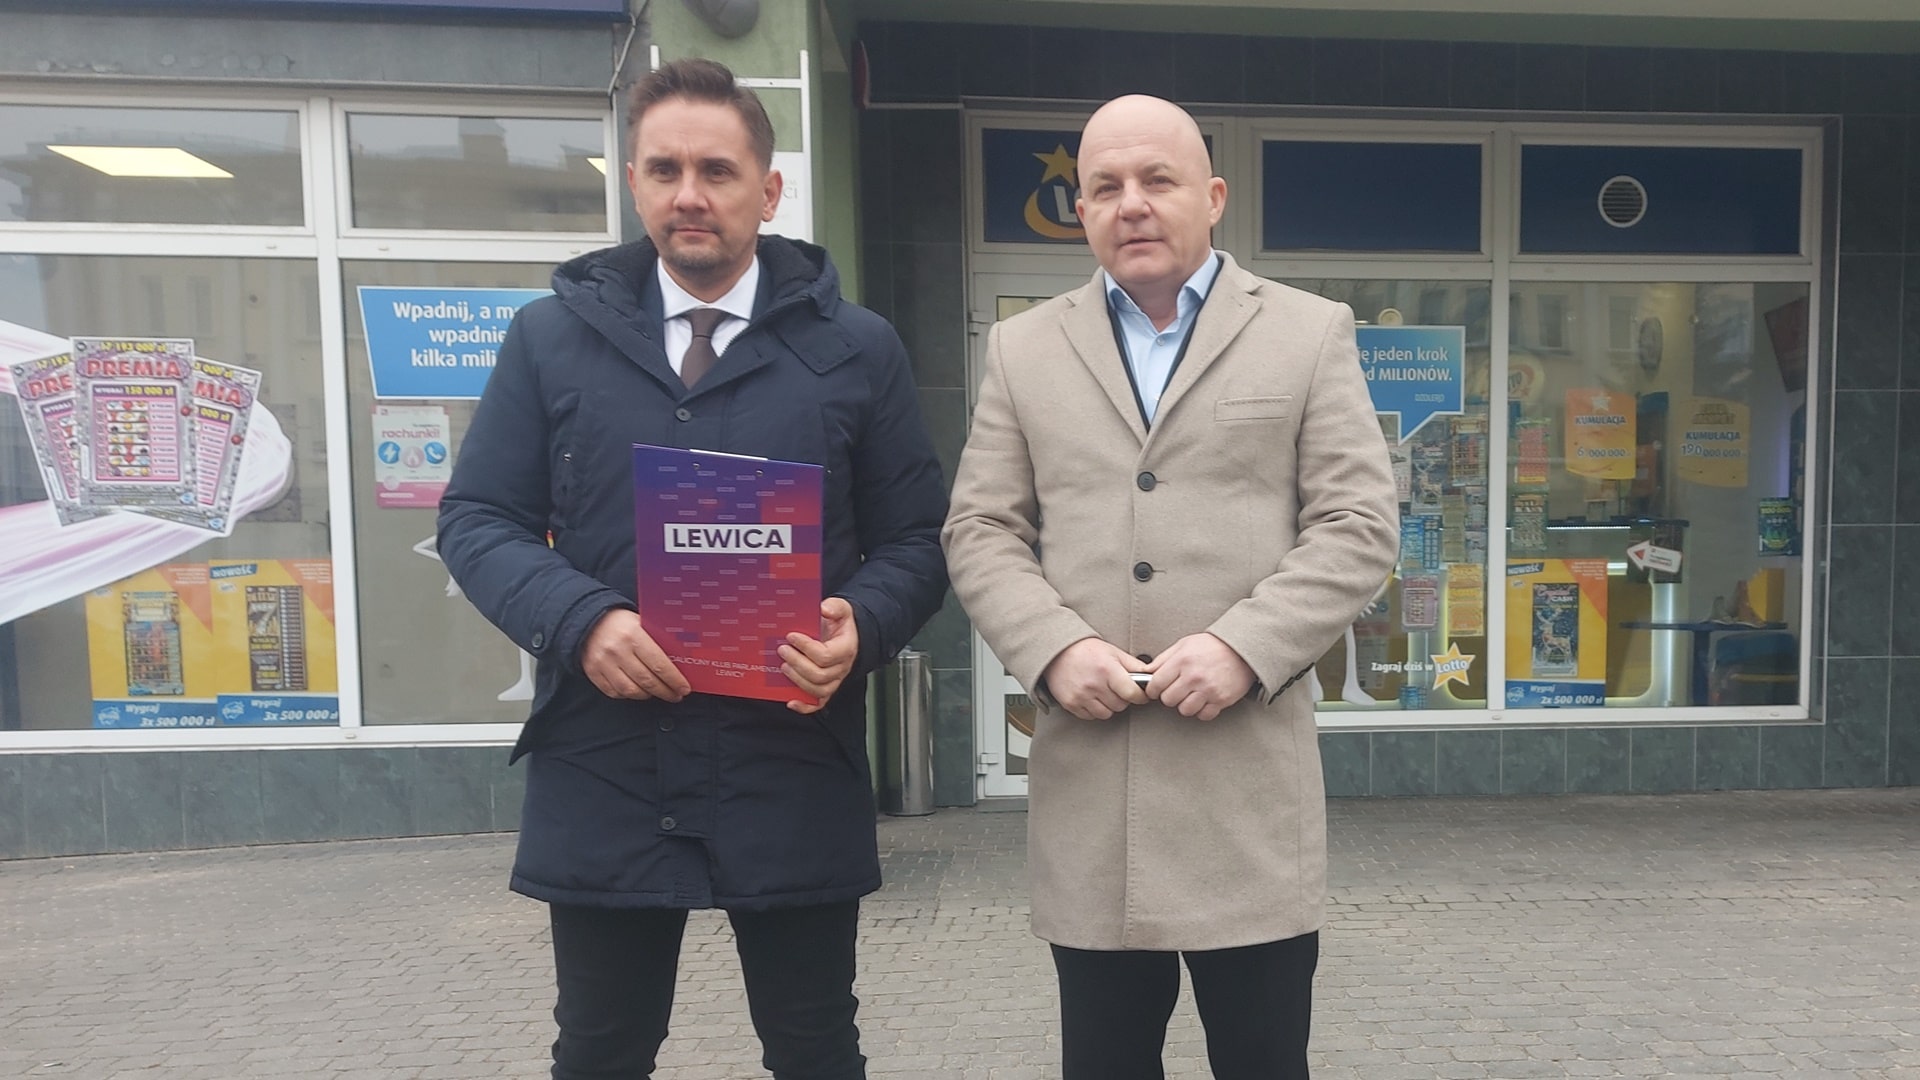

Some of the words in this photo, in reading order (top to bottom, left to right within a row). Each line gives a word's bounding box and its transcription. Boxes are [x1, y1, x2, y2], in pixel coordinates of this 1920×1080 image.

[393, 302, 474, 321] Wpadnij,
[480, 306, 491, 320] a
[496, 306, 520, 320] m
[411, 349, 457, 367] kilka
[462, 349, 498, 367] mili
[1372, 346, 1413, 364] jeden
[1417, 346, 1448, 361] krok
[86, 360, 182, 377] PREMIA
[1378, 364, 1453, 381] MILIONÓW.
[28, 374, 73, 398] PRE
[195, 380, 242, 405] MIA
[1575, 416, 1626, 425] KUMULACJA
[1686, 431, 1741, 441] KUMULACJA
[672, 528, 785, 549] LEWICA
[211, 564, 253, 578] NOWOŚĆ
[1507, 562, 1541, 576] NOWOŚĆ
[711, 660, 731, 669] KLUB
[732, 662, 782, 674] PARLAMENTA
[716, 669, 745, 678] LEWICY
[1371, 661, 1402, 673] Zagraj
[1404, 661, 1423, 671] dziś
[1437, 660, 1468, 674] Lotto
[1530, 684, 1556, 694] Wygraj
[251, 698, 281, 709] Wygraj
[1541, 696, 1553, 704] 2x
[1554, 695, 1573, 705] 500
[1575, 695, 1595, 704] 000
[125, 703, 160, 714] Wygraj
[263, 710, 279, 721] 3x
[280, 710, 302, 721] 500
[306, 710, 329, 720] 000
[330, 710, 338, 720] zł
[139, 717, 154, 728] 3x
[156, 716, 177, 727] 500
[179, 716, 204, 727] 000
[205, 716, 215, 727] zł
